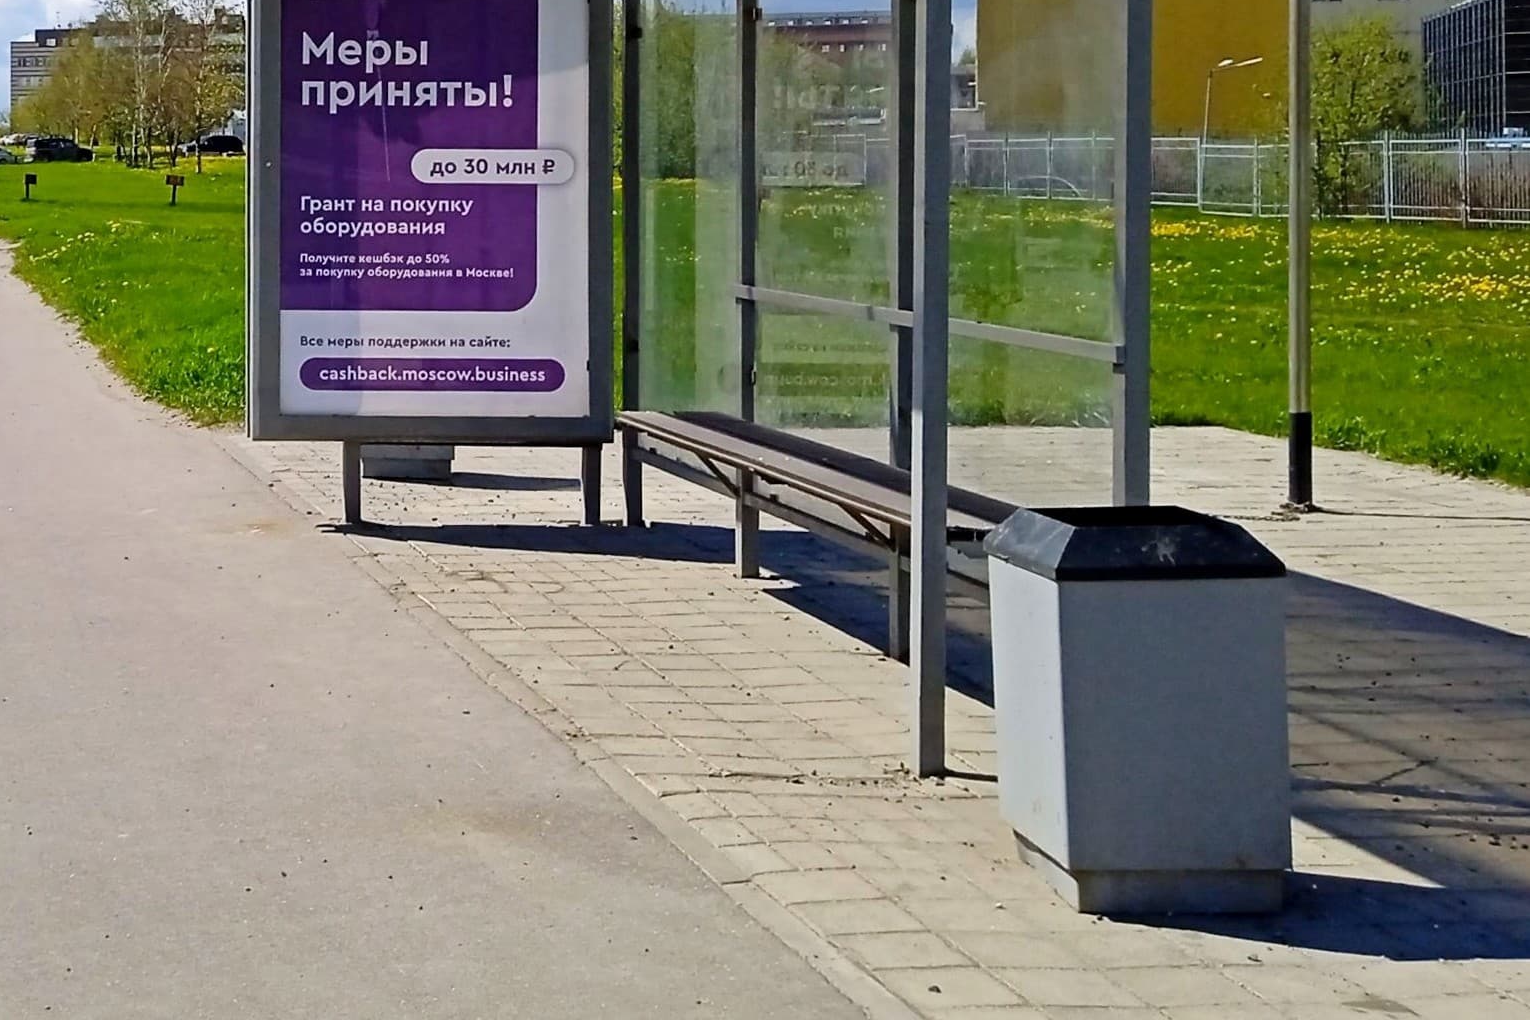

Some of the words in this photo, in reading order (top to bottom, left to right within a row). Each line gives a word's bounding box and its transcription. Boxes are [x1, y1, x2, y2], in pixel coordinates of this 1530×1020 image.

[302, 31, 428, 74] Меры
[301, 74, 513, 114] приняты!
[430, 162, 457, 177] до
[464, 159, 488, 175] 30
[496, 161, 536, 175] млн
[300, 196, 356, 215] Грант
[361, 199, 384, 212] на
[390, 199, 474, 216] покупку
[300, 217, 446, 238] оборудования
[299, 253, 356, 265] Получите
[358, 252, 404, 264] кешбэк
[406, 256, 423, 266] до
[425, 253, 450, 264] 50%
[299, 268, 313, 277] за
[315, 268, 365, 279] покупку
[367, 266, 453, 278] оборудования
[455, 269, 463, 277] в
[465, 267, 515, 278] Москве!
[300, 336, 324, 347] Все
[327, 338, 364, 349] меры
[368, 338, 446, 349] поддержки
[449, 338, 466, 348] на
[469, 336, 512, 349] сайте:
[319, 365, 546, 382] cashback.moscow.business
